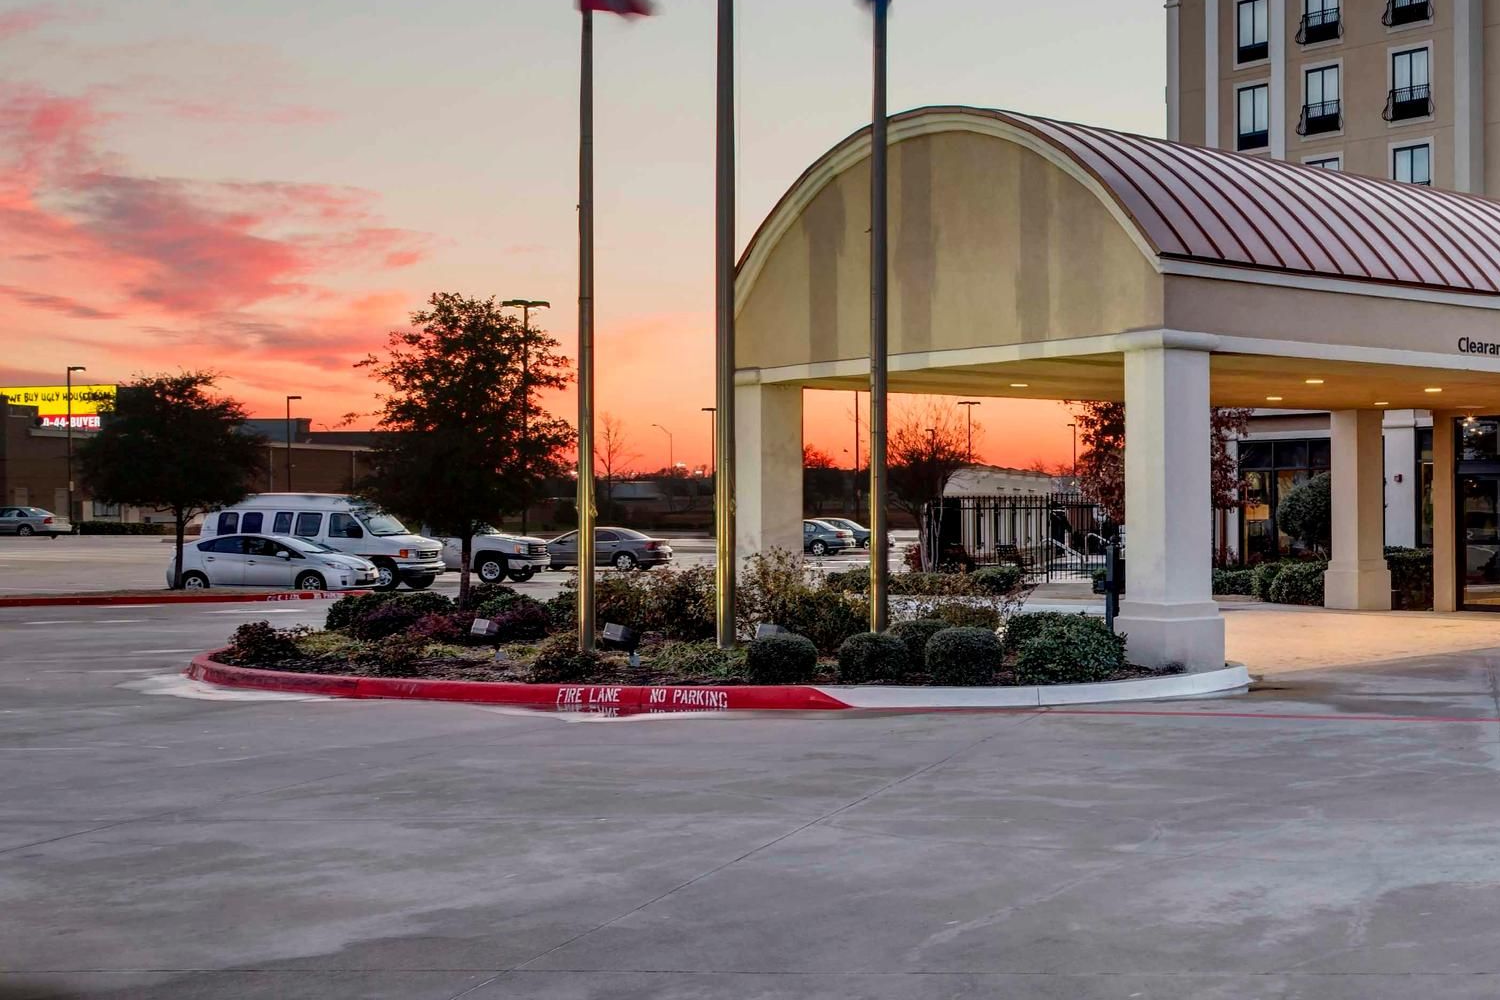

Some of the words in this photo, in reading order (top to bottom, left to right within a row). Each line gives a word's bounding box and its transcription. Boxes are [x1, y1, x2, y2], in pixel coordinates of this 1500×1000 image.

[9, 394, 21, 402] WE
[24, 392, 38, 402] BUY
[41, 392, 59, 402] UGLY
[556, 688, 584, 703] FIRE
[589, 687, 622, 703] LANE
[650, 688, 666, 703] NO
[673, 689, 727, 708] PARKING
